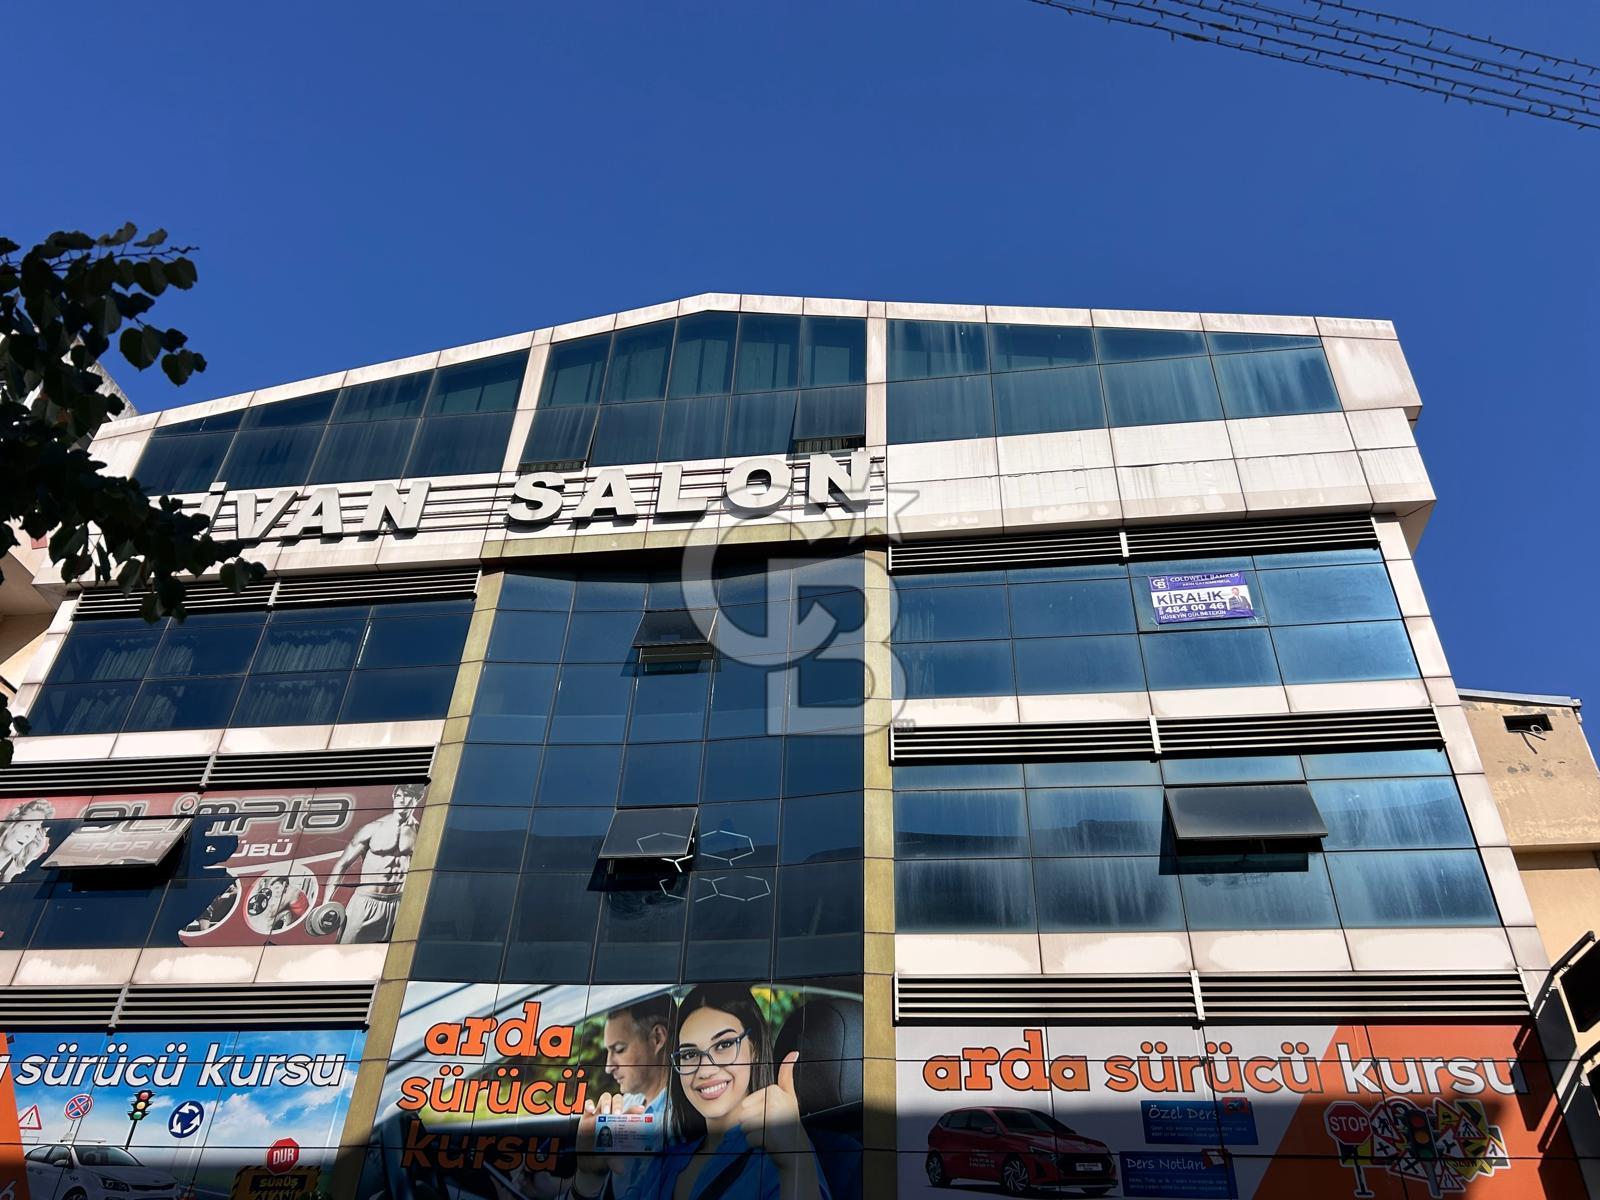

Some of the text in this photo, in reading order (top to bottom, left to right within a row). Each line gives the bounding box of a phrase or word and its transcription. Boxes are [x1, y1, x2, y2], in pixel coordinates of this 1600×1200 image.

[506, 450, 872, 530] SALON
[1156, 590, 1226, 606] KİRALIK
[1166, 605, 1188, 614] 484
[1190, 603, 1206, 611] 00
[1209, 602, 1225, 610] 46
[424, 1001, 575, 1058] arda
[15, 1042, 188, 1087] sürücü
[197, 1043, 347, 1087] kursu
[923, 1029, 1531, 1095] arda sürücü kursu
[396, 1064, 588, 1116] sürücü
[1148, 1104, 1219, 1120] Özel Ders
[1329, 1115, 1370, 1135] STOP
[272, 1147, 294, 1165] DUR
[402, 1118, 561, 1172] kursu
[1126, 1155, 1207, 1170] Ders Notları
